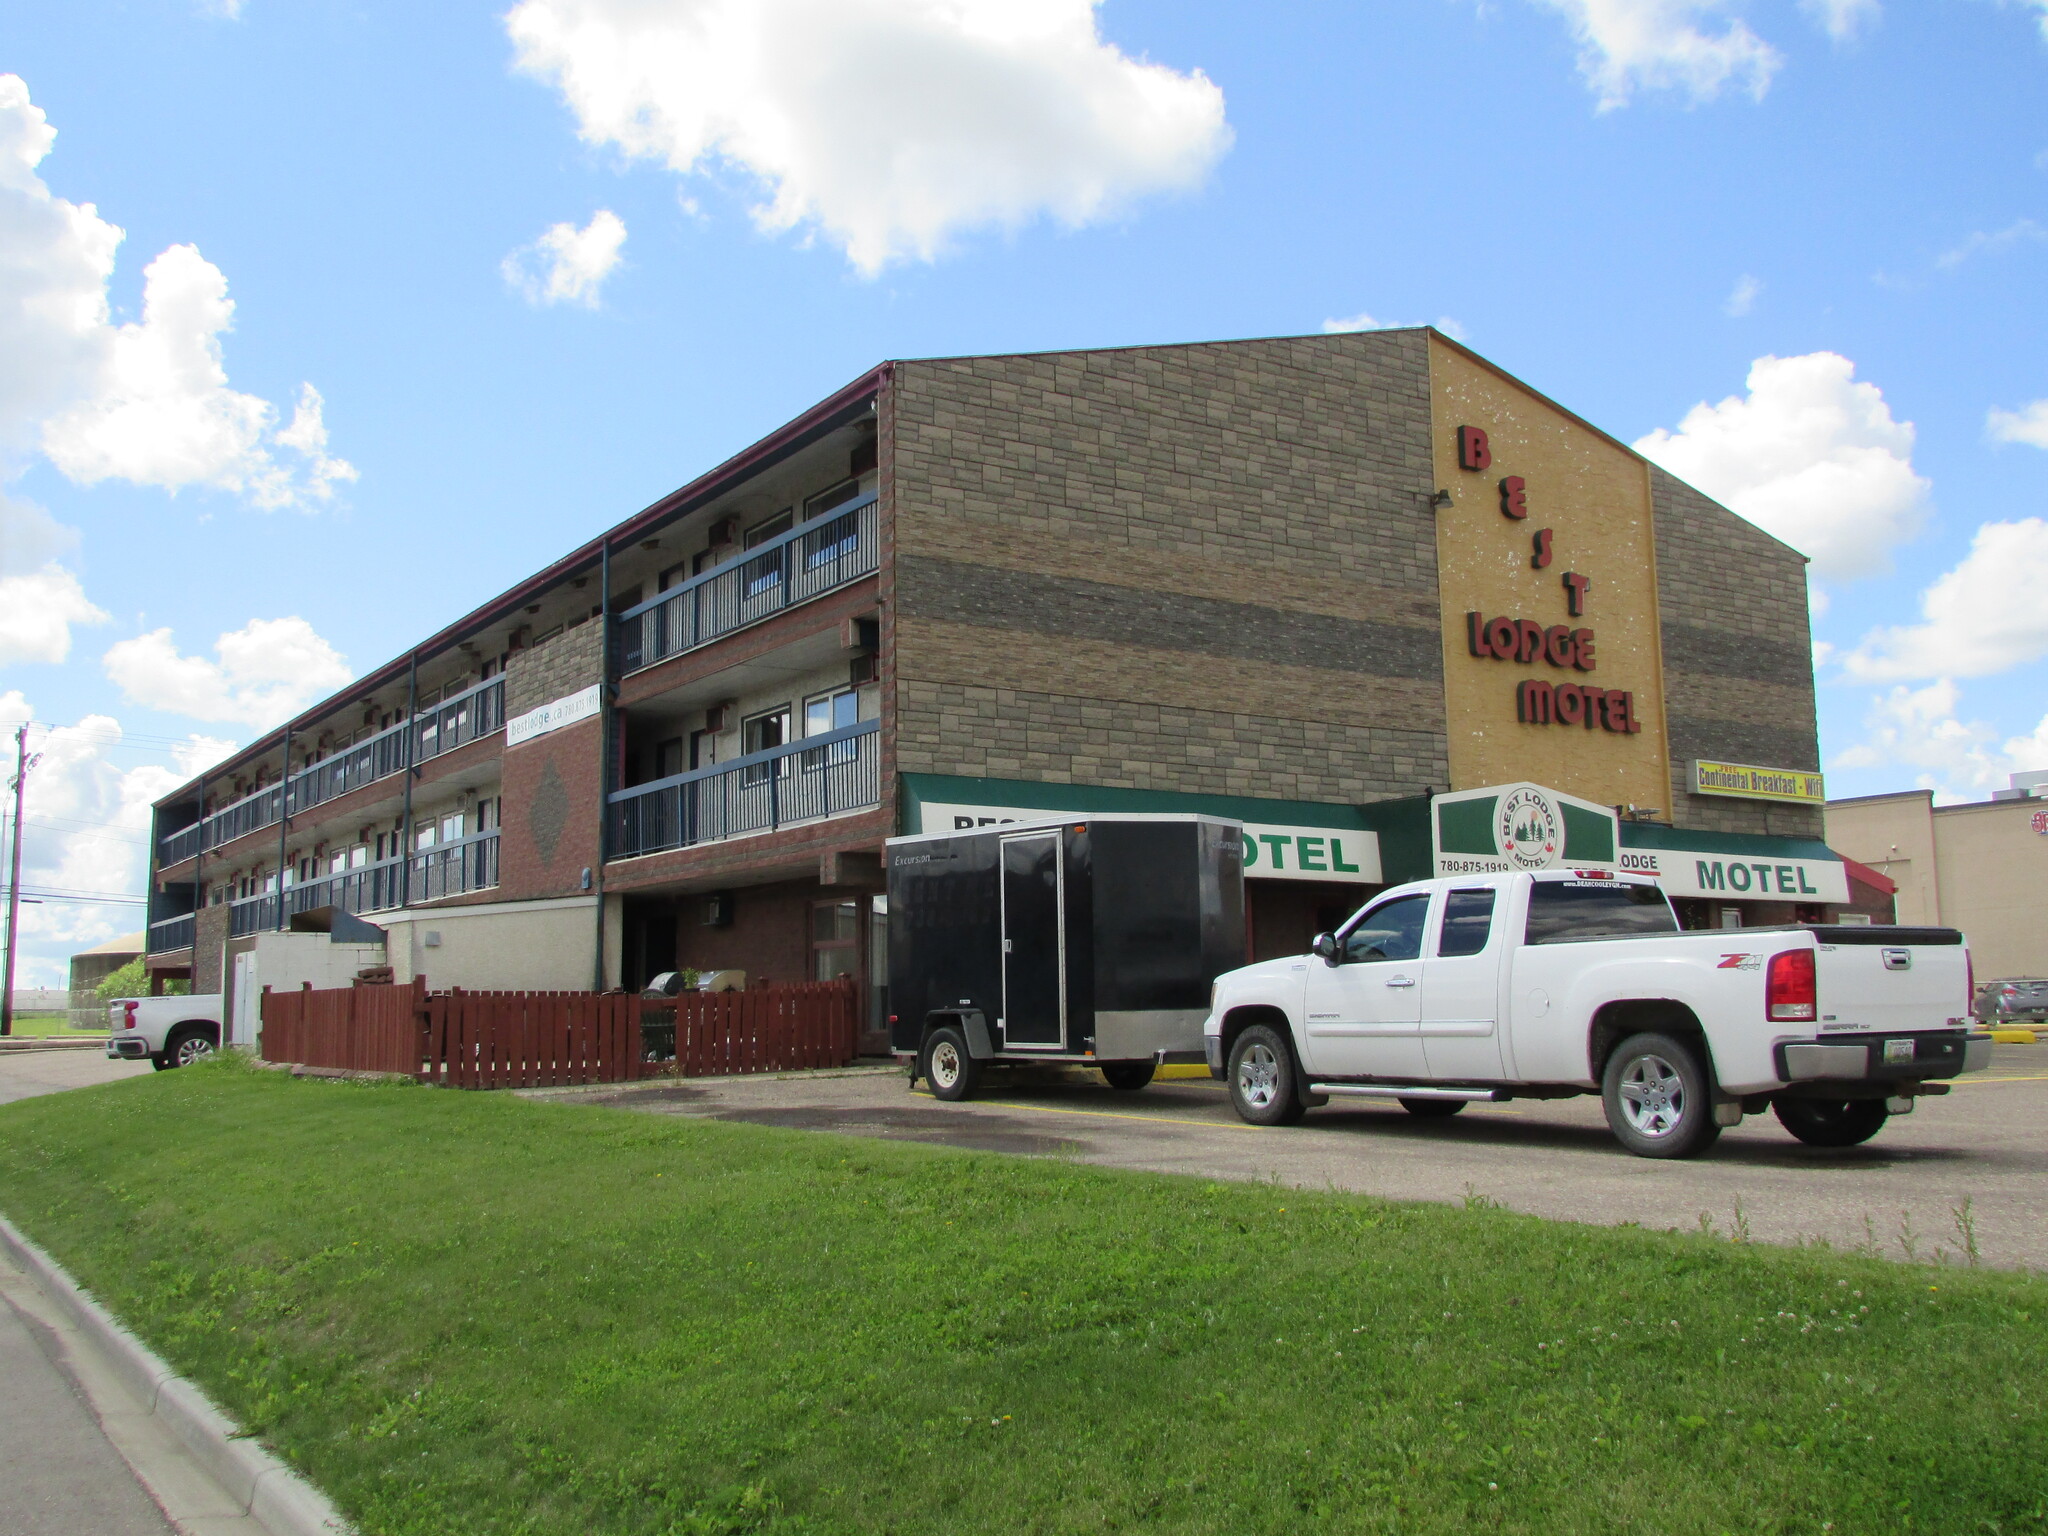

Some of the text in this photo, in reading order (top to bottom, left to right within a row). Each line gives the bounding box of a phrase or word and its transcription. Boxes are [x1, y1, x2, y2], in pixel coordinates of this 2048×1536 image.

[1457, 425, 1590, 617] BEST
[1467, 611, 1596, 671] LODGE
[511, 706, 562, 736] bestlodge.ca
[1517, 680, 1640, 733] MOTEL
[1699, 767, 1748, 789] Continental
[1751, 772, 1797, 794] Breakfast
[1720, 765, 1738, 774] FREE
[1503, 792, 1554, 838] BEST LODGE
[894, 854, 931, 866] Excursion
[1243, 832, 1360, 873] OTEL
[1440, 861, 1509, 872] 780-875-1919
[1514, 853, 1546, 867] MOTEL
[1619, 854, 1658, 869] ODGE
[1696, 860, 1817, 894] MOTEL
